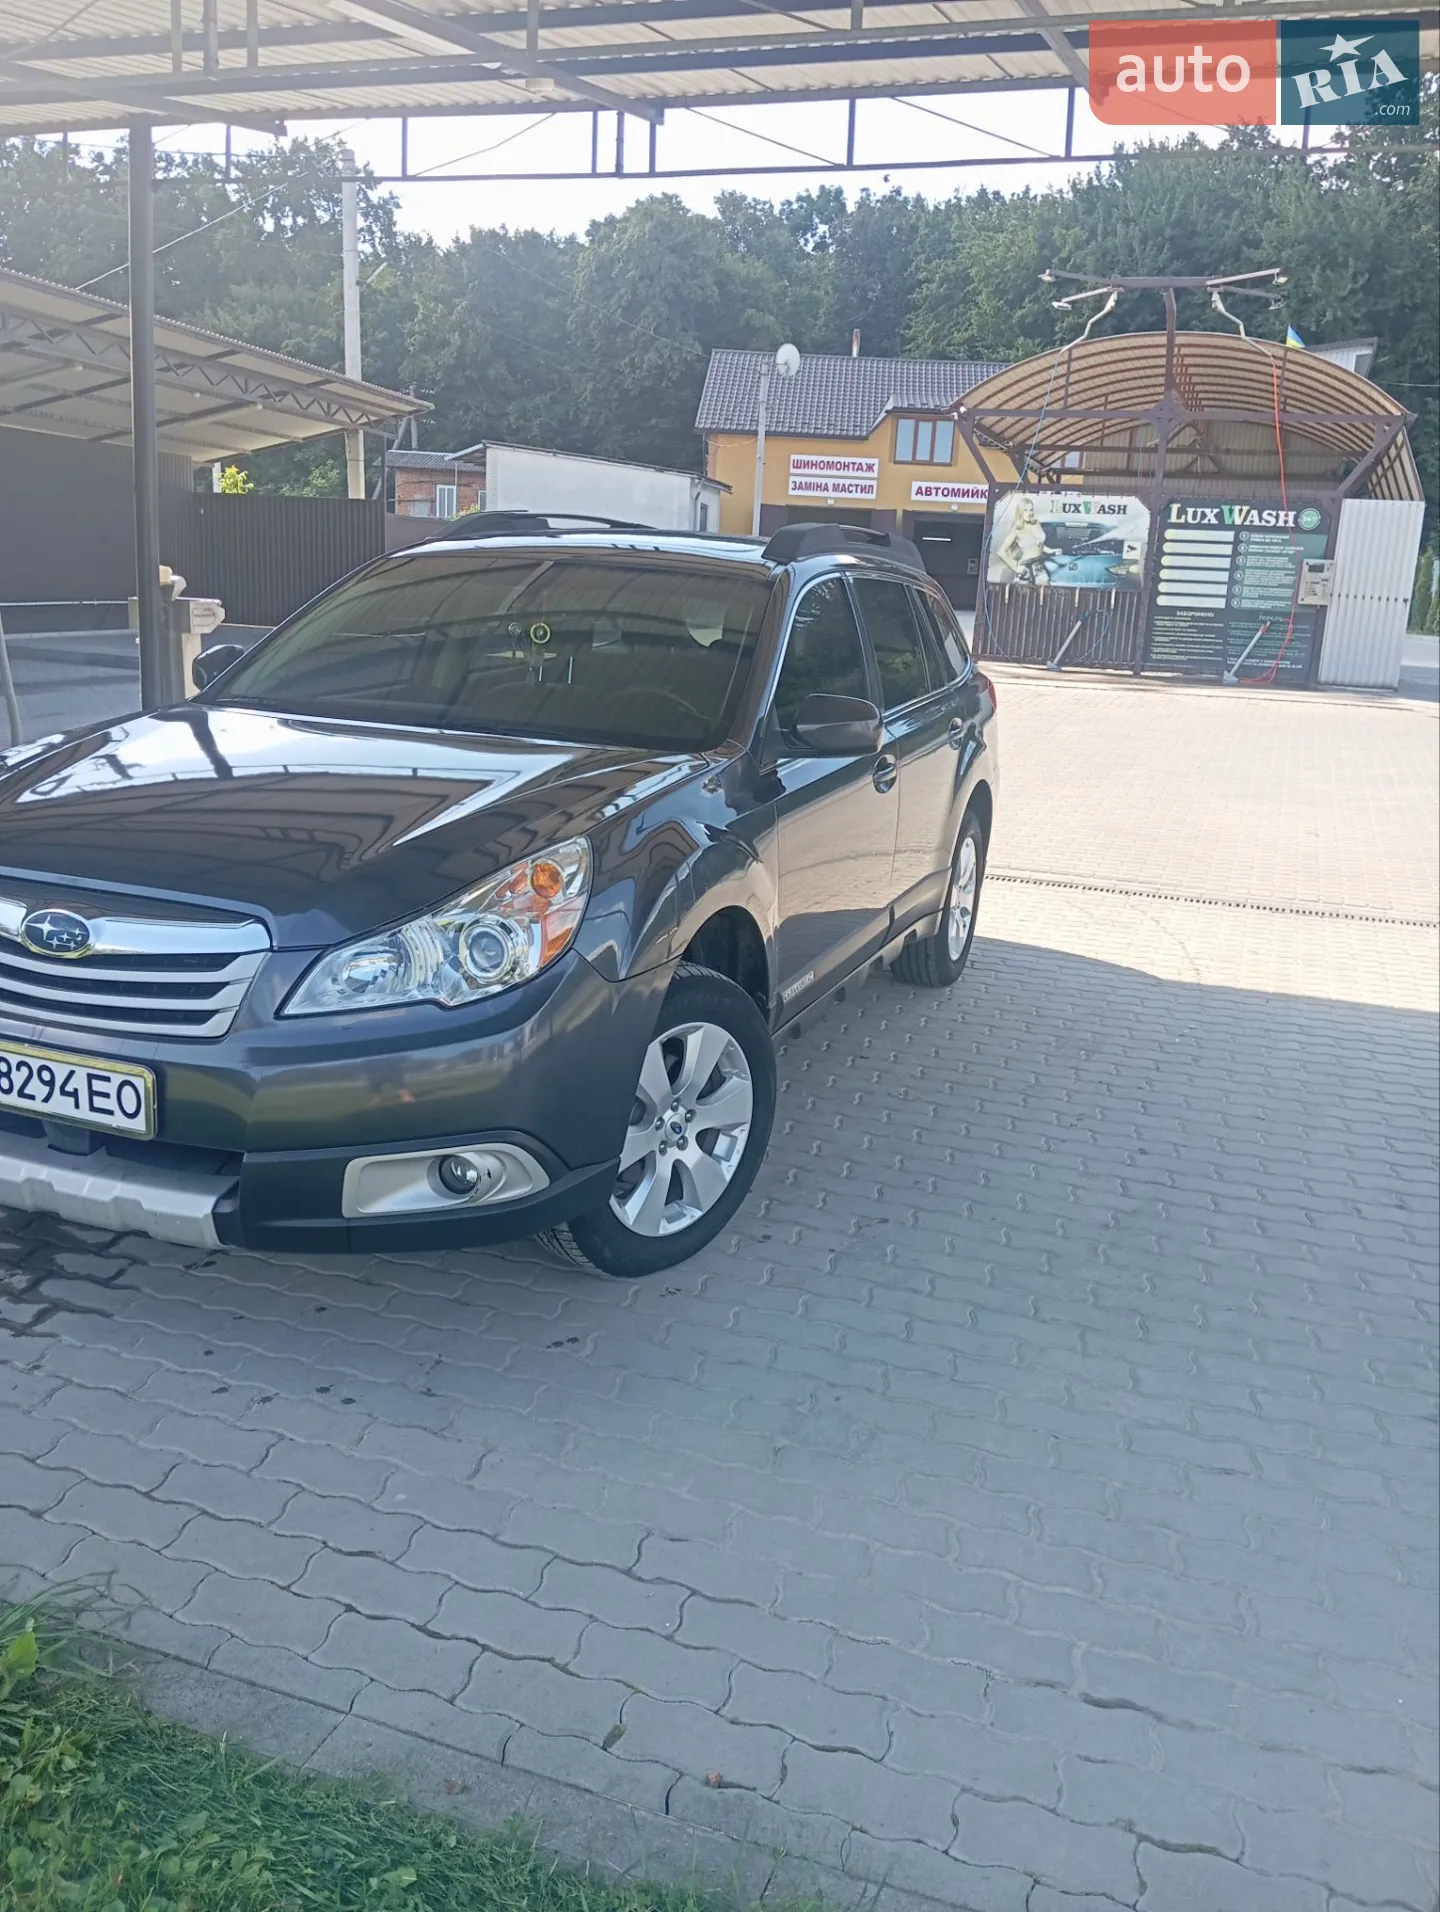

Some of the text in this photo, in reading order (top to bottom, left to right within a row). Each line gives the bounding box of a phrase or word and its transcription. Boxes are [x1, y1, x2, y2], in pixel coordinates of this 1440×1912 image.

[792, 459, 875, 473] ШИНОМОНТАЖ
[791, 481, 874, 495] ЗАМІНА МАСТИЛ
[0, 1056, 142, 1120] 8294EO
